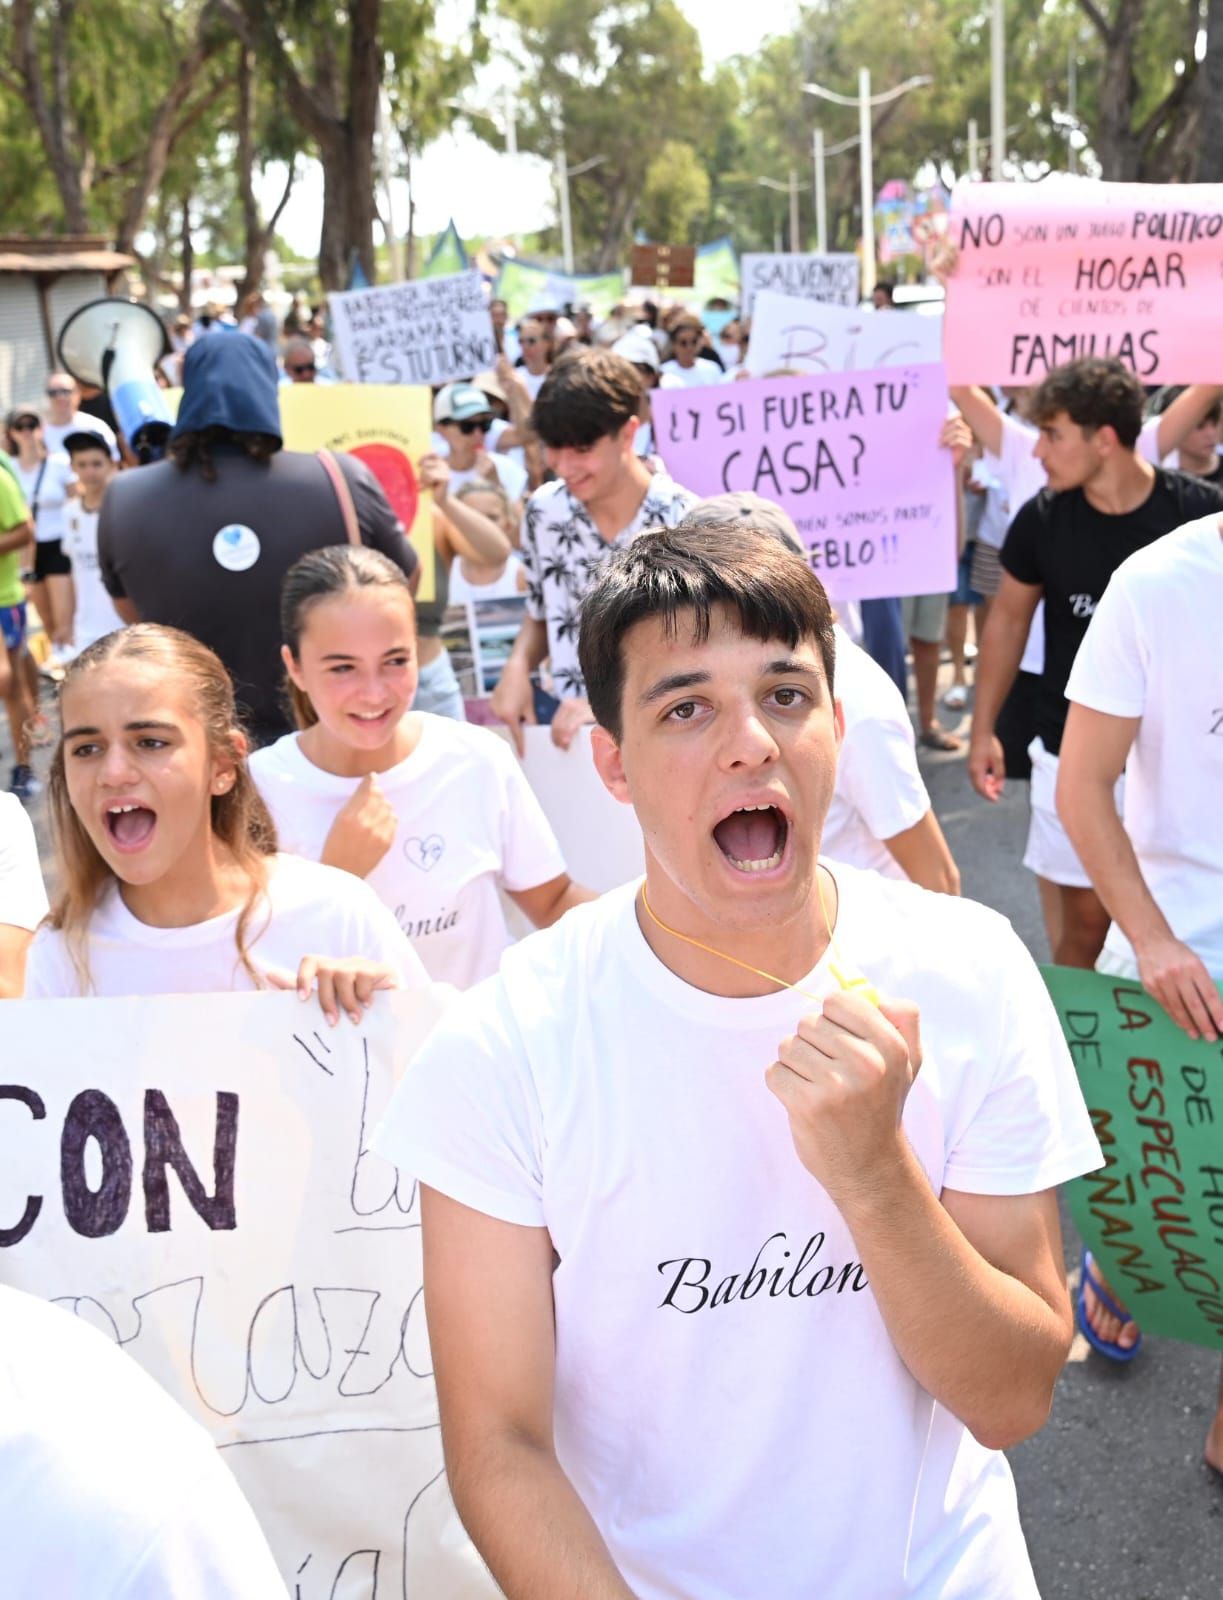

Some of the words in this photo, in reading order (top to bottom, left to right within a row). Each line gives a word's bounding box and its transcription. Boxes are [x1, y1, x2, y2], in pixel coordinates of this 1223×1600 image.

[960, 213, 1005, 250] NO
[1014, 224, 1048, 246] SON
[1056, 225, 1078, 241] UN
[1023, 266, 1044, 287] EL
[1075, 252, 1186, 292] HOGAR
[1020, 298, 1042, 318] DE
[717, 402, 745, 436] SI
[763, 384, 865, 433] FUERA
[875, 382, 907, 414] TU
[721, 434, 866, 496] CASA?
[1113, 987, 1152, 1030] LA
[1065, 1010, 1102, 1069] DE
[0, 1084, 239, 1247] CON
